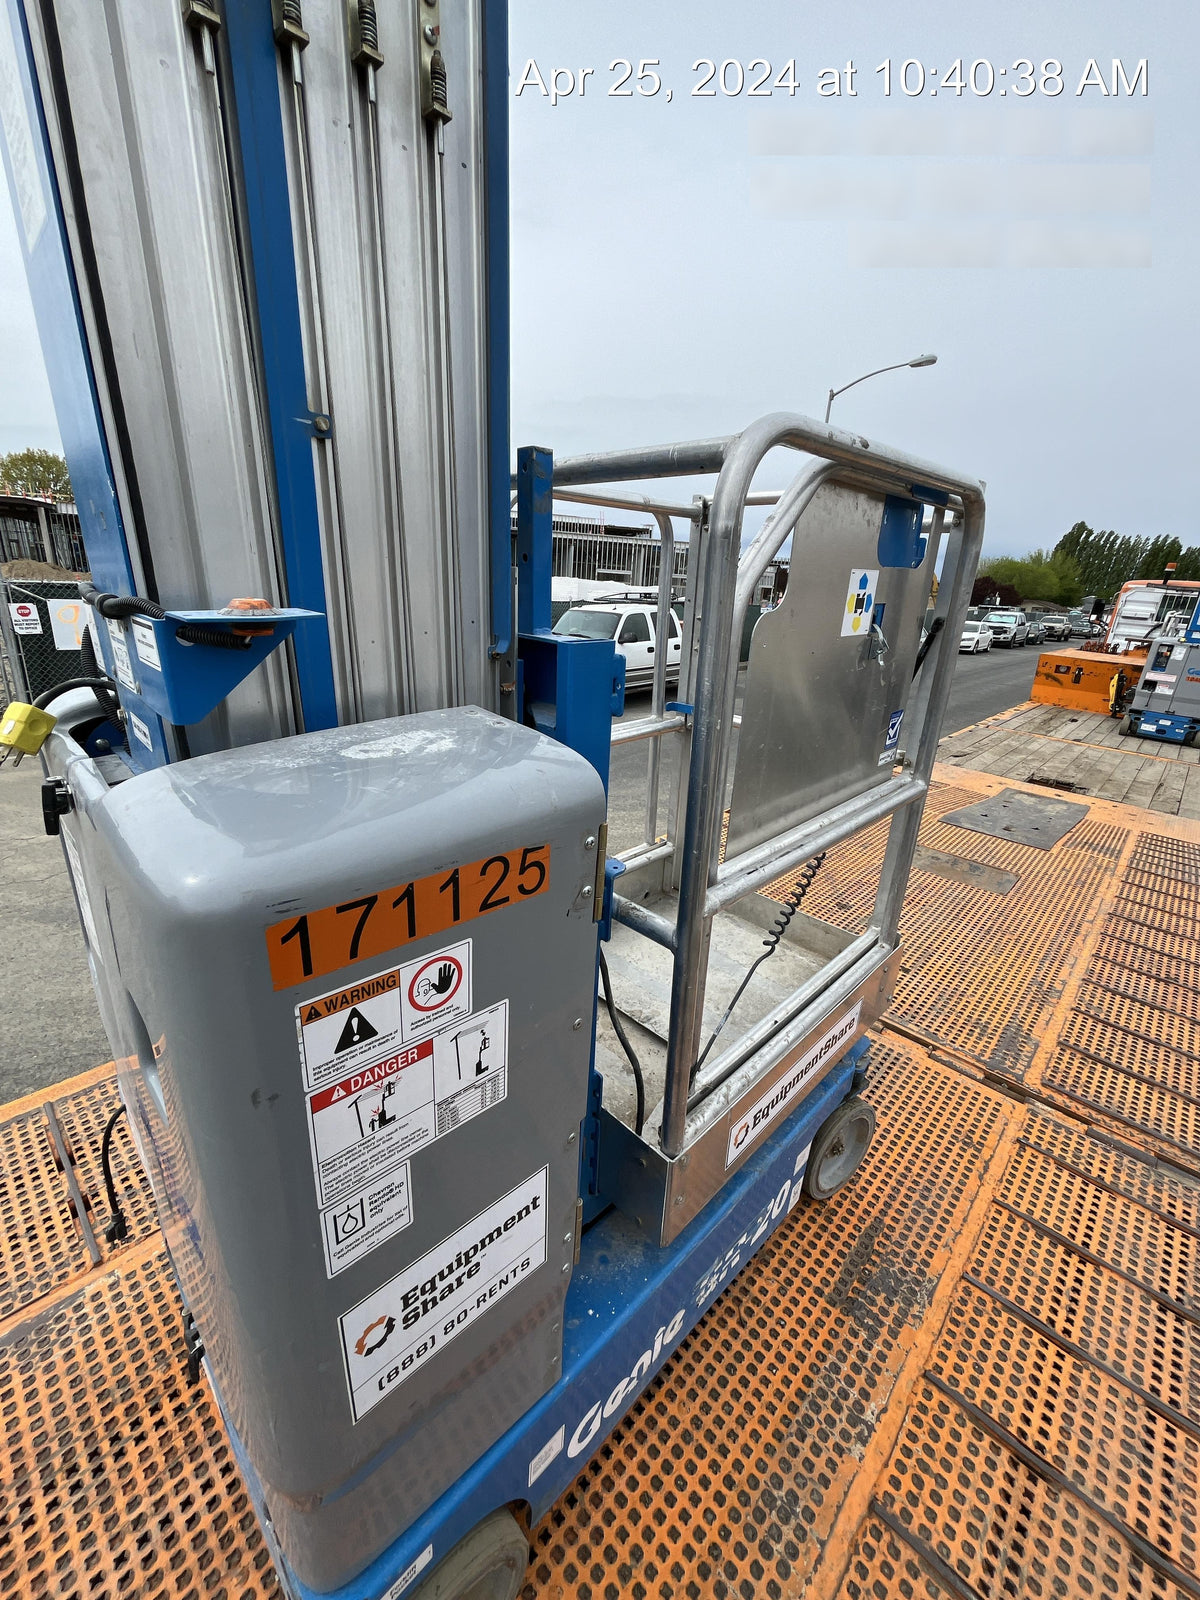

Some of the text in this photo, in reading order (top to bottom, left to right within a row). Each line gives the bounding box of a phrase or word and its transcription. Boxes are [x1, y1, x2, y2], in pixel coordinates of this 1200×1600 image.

[280, 846, 548, 978] 171125
[324, 974, 397, 1013] WARNING
[350, 1048, 419, 1093] DANGER
[751, 1016, 856, 1131] EquipmentShare
[368, 1182, 395, 1200] Chevron
[369, 1190, 402, 1212] equivalent
[370, 1207, 384, 1218] only
[400, 1195, 541, 1313] Equipment
[378, 1256, 531, 1392] (888) 80-RENTS
[402, 1261, 481, 1331] Share
[567, 1309, 686, 1458] Genie
